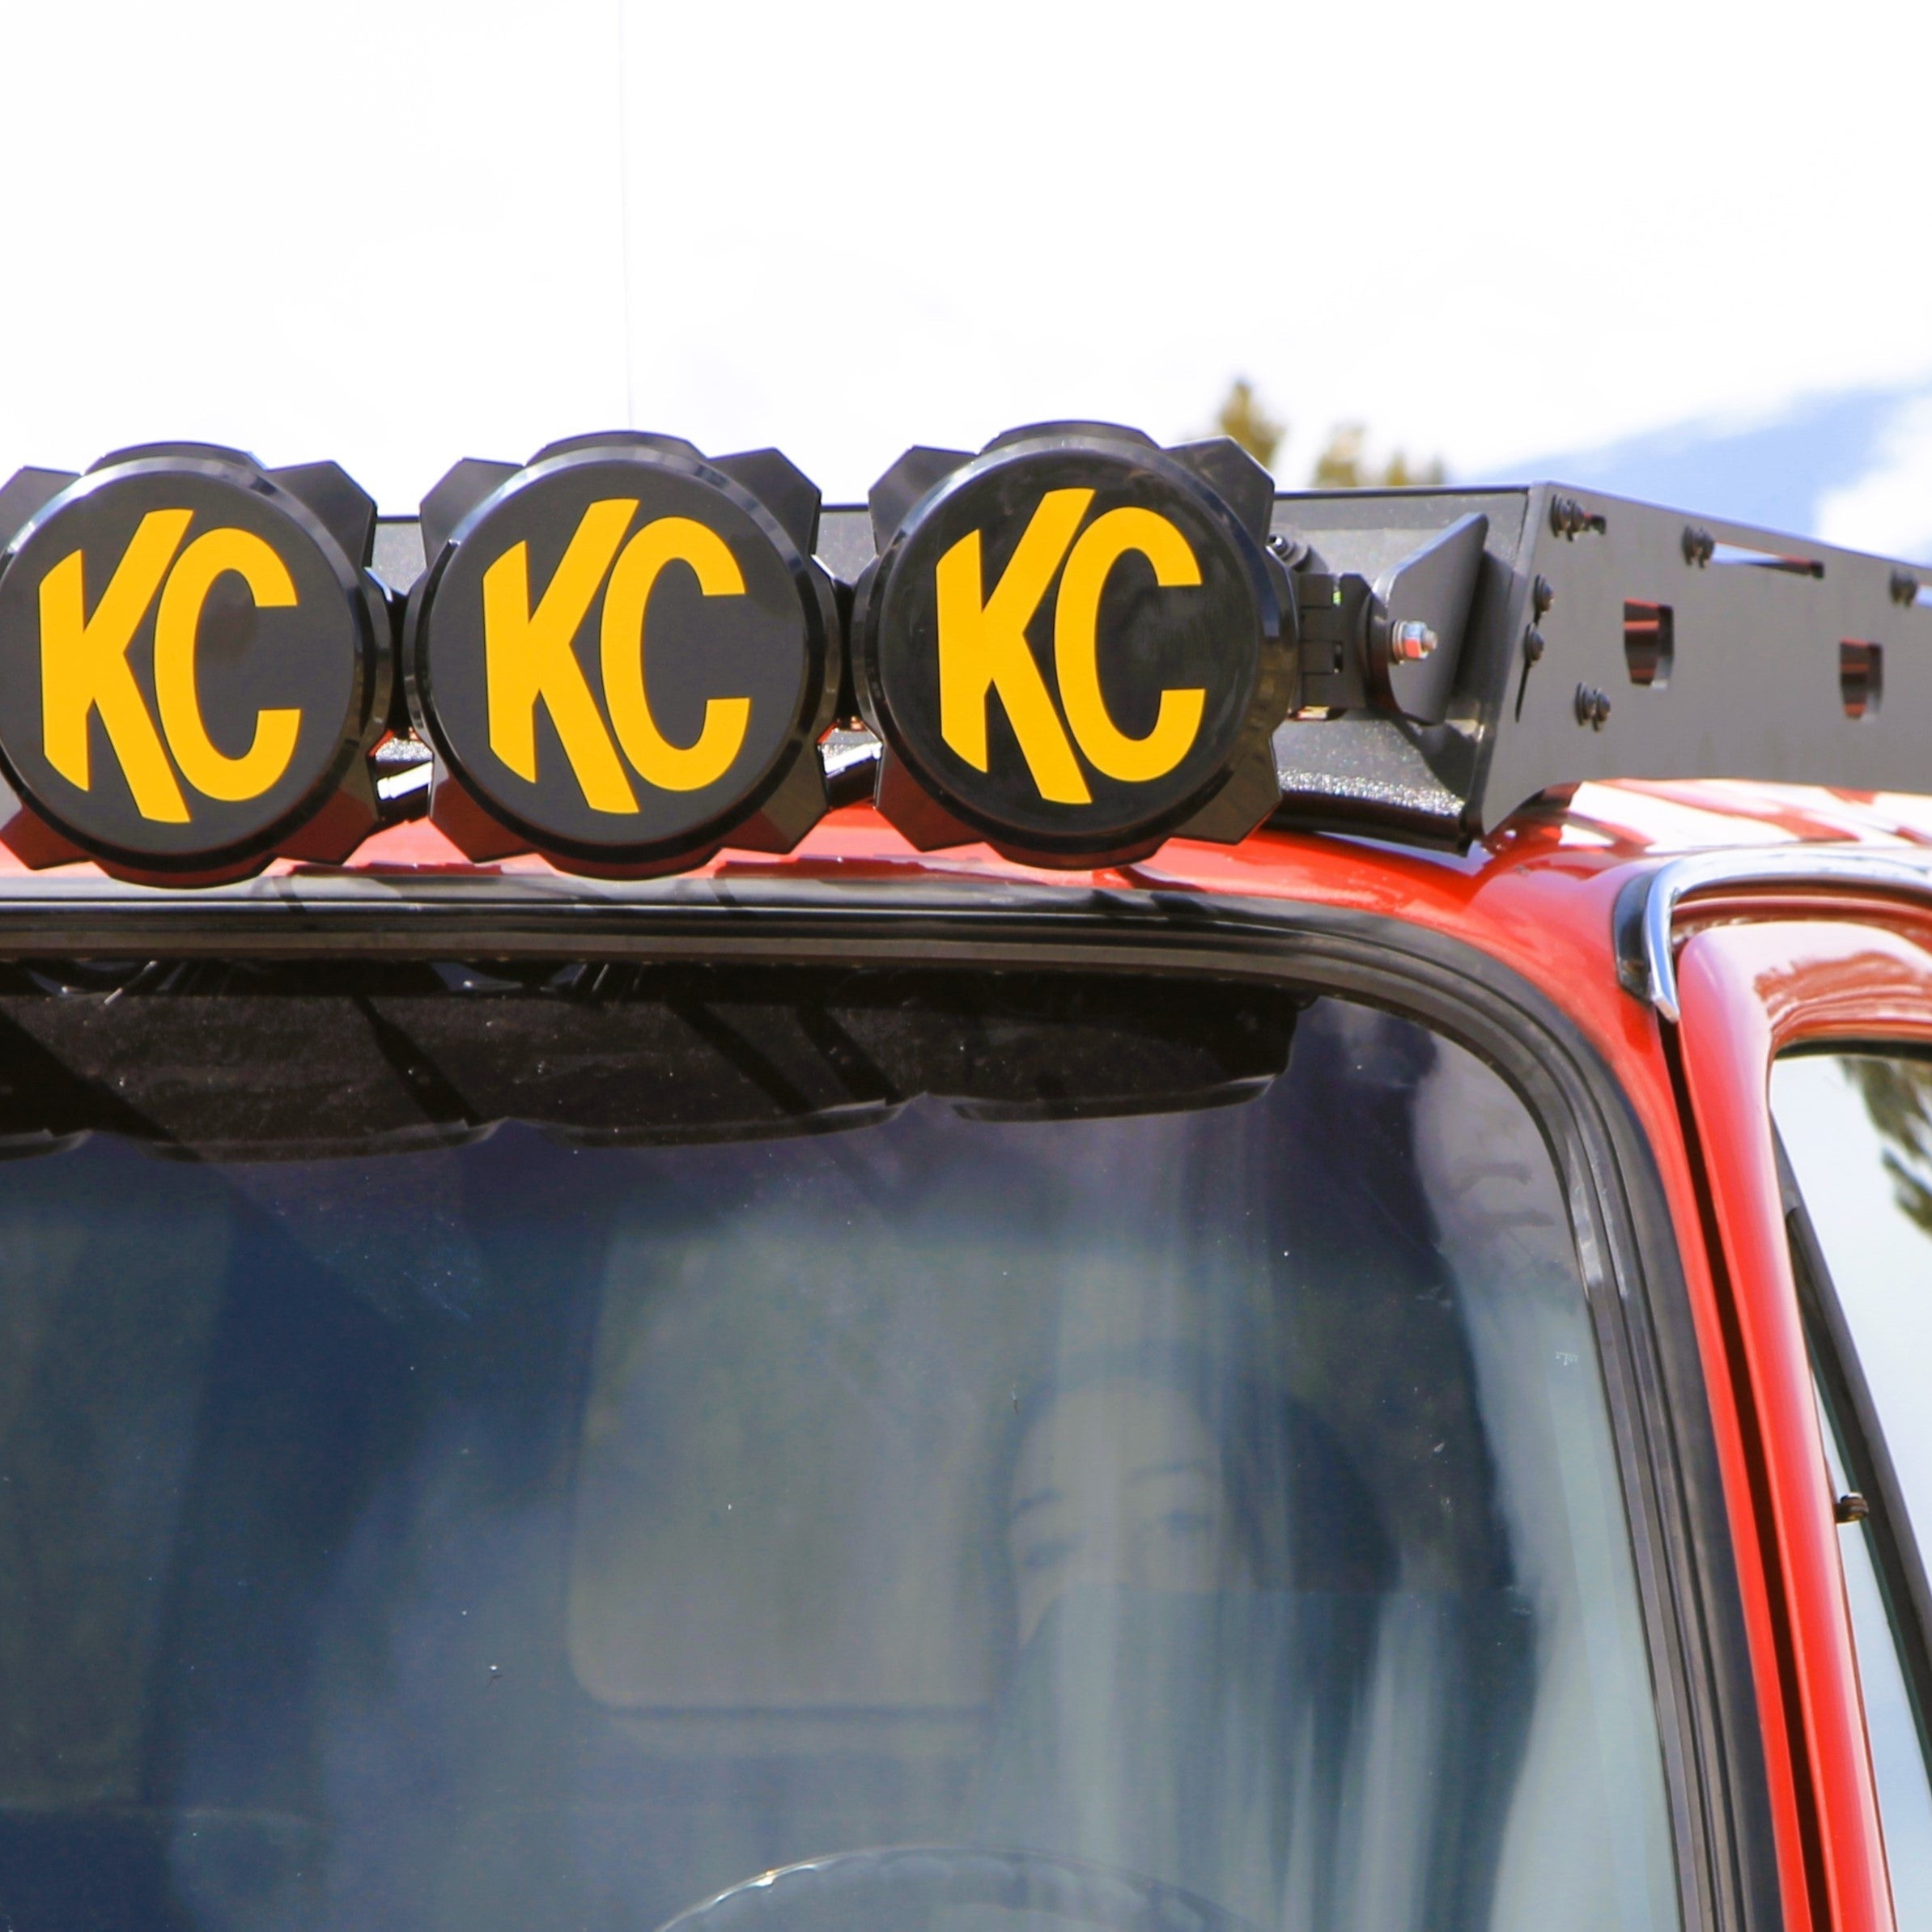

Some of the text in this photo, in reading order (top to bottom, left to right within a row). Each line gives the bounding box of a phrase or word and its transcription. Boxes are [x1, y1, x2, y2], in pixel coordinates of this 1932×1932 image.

[39, 509, 301, 823] KC
[483, 499, 750, 813] KC
[936, 488, 1205, 804] KC
